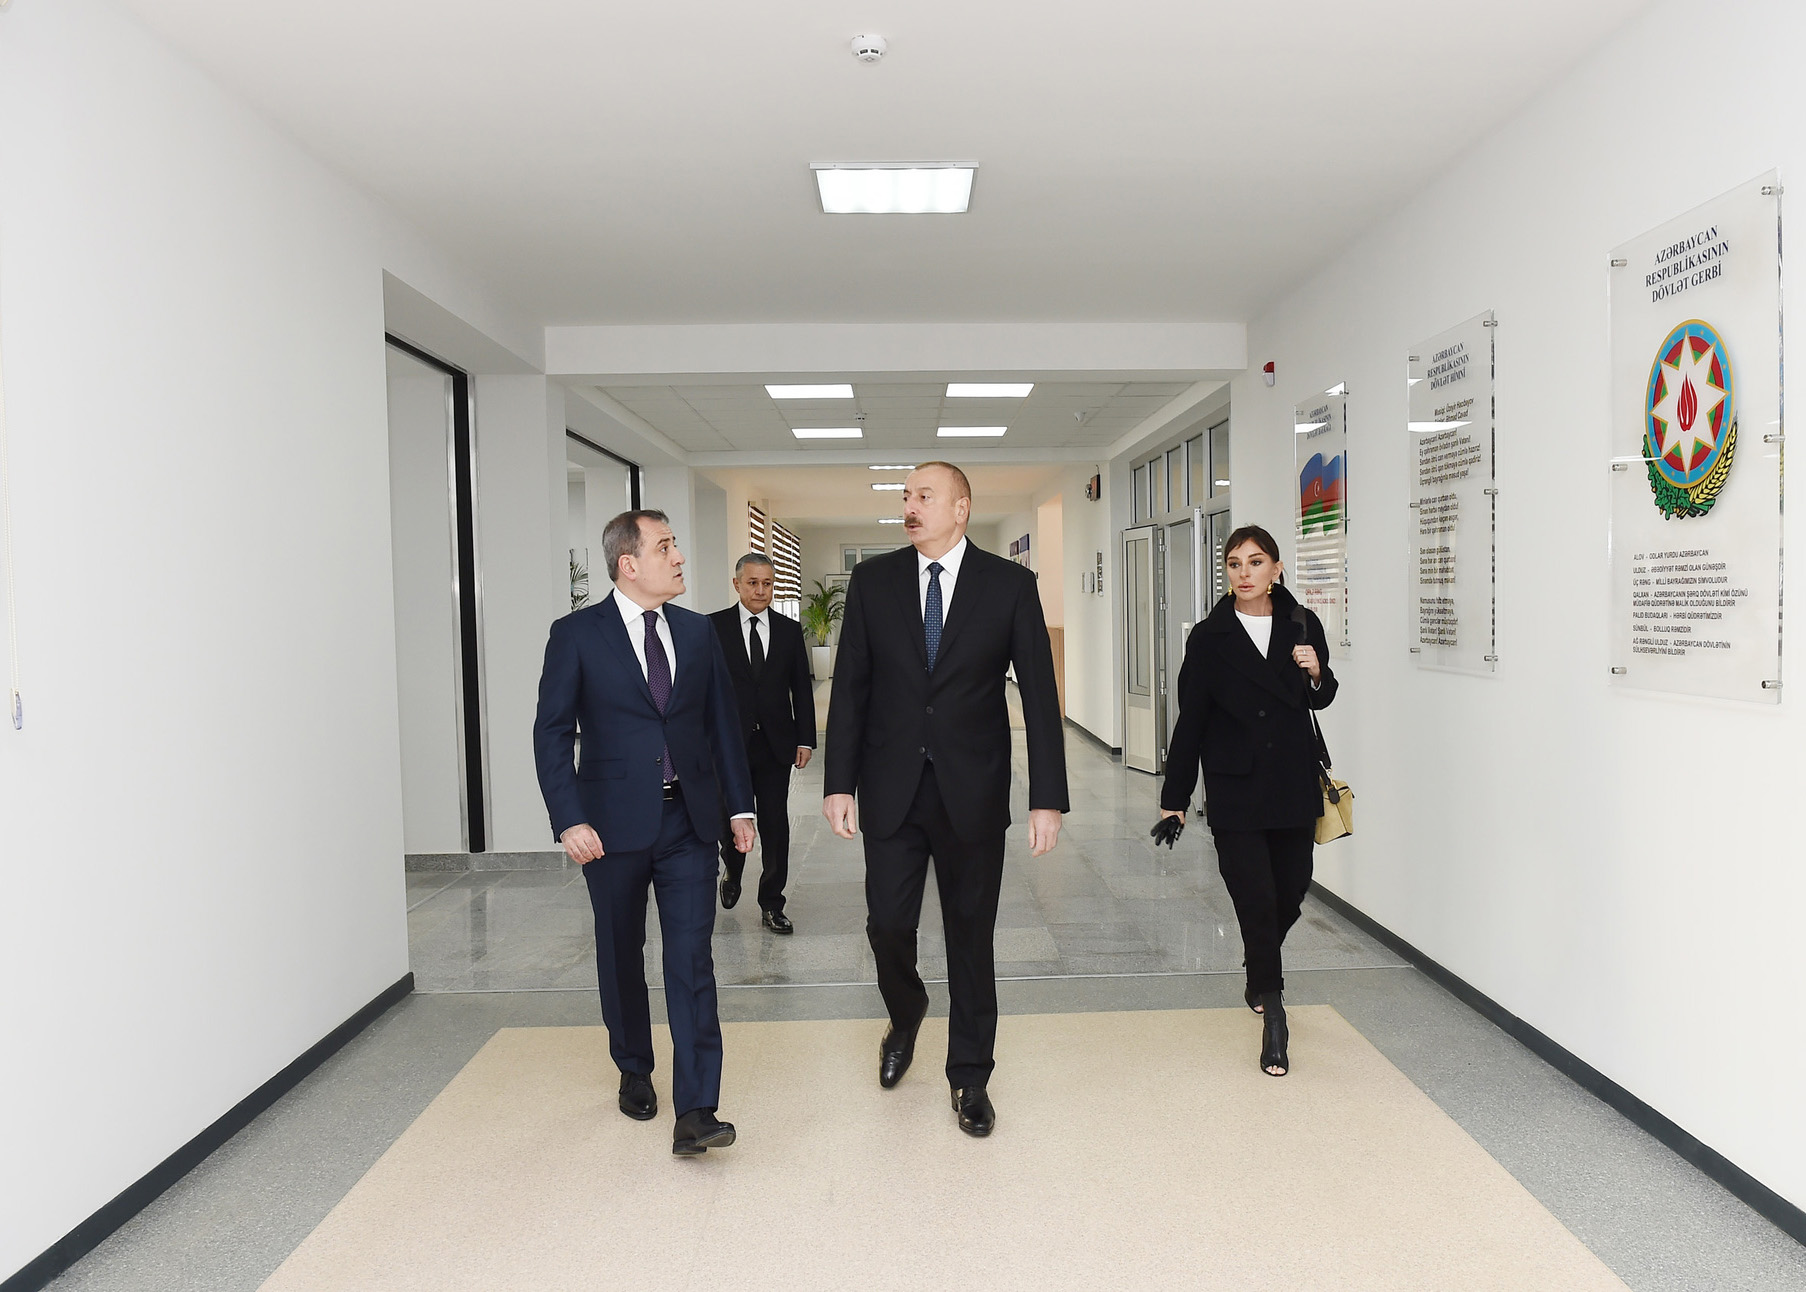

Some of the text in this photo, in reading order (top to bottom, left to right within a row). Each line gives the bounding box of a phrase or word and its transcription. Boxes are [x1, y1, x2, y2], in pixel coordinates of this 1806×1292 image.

[1645, 240, 1729, 287] RESPUBLİKASININ
[1654, 225, 1718, 265] AZƏRBAYCAN
[1652, 260, 1722, 303] DÖVLƏT GERBİ
